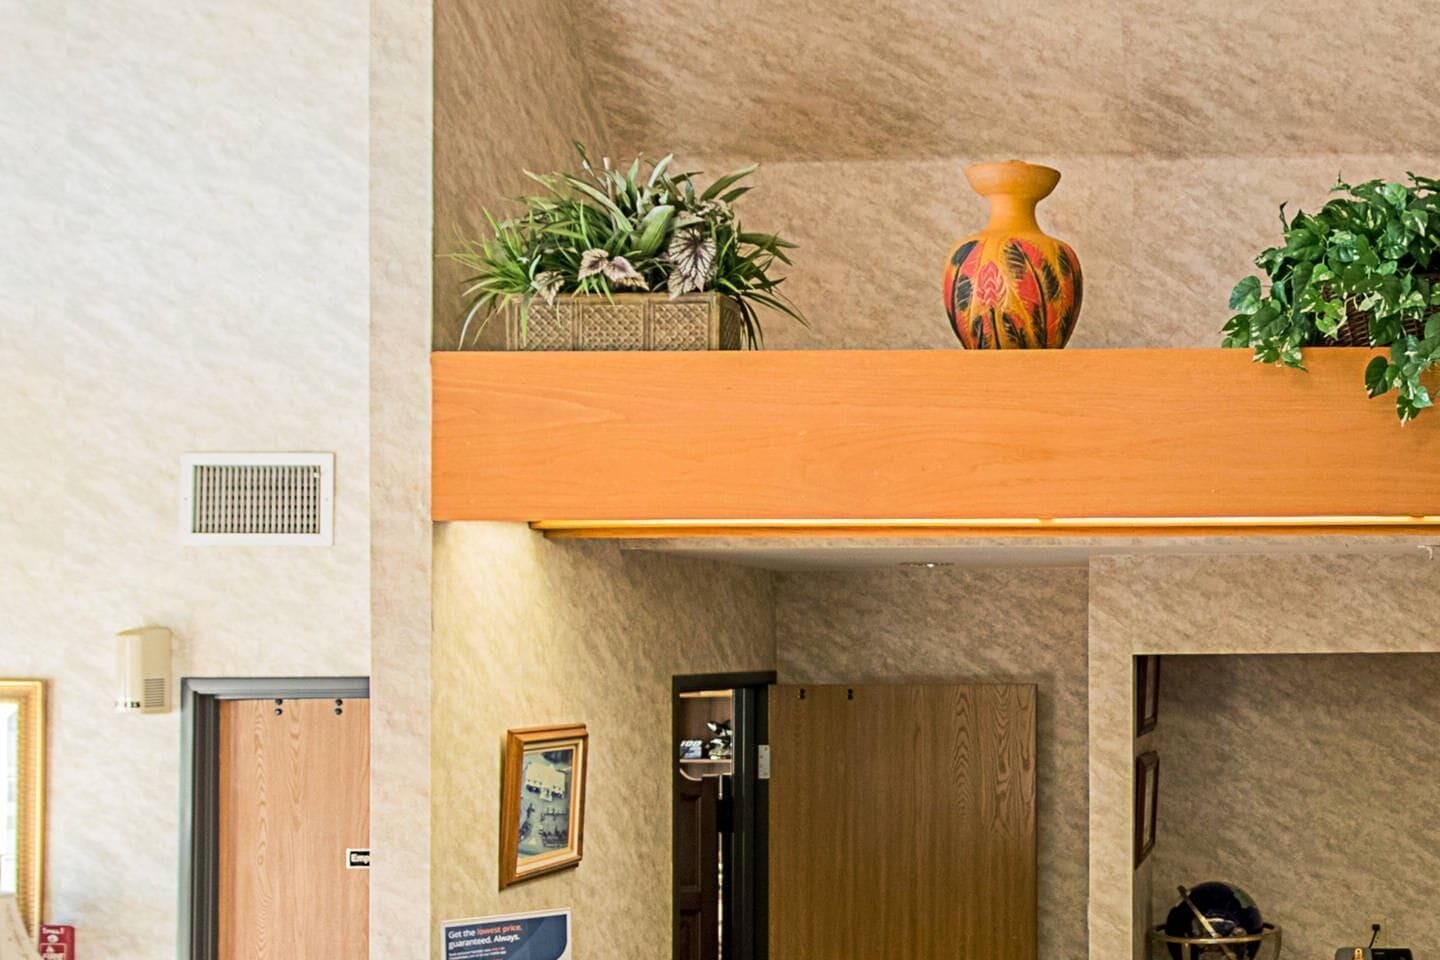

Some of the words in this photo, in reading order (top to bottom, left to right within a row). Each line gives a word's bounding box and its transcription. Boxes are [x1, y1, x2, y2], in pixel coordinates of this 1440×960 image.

[448, 931, 462, 939] Get
[463, 929, 476, 937] the
[476, 928, 501, 936] lowest
[493, 934, 521, 943] Always.
